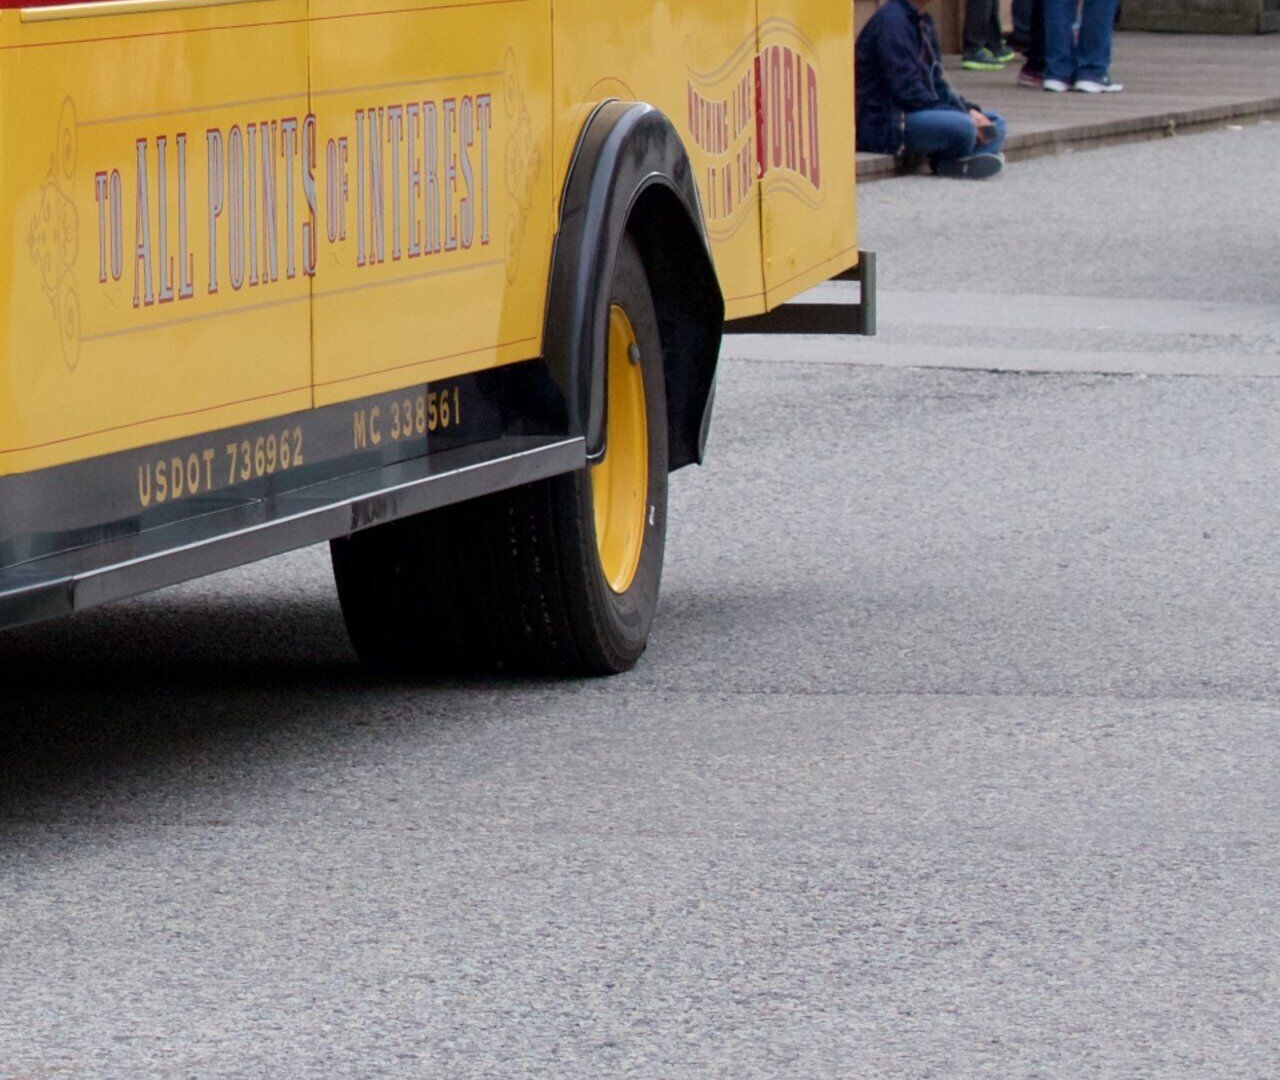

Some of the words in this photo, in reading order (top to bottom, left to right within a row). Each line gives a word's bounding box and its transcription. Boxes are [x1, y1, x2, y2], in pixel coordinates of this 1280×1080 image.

[754, 45, 821, 191] WORLD
[95, 168, 122, 283] TO
[133, 132, 193, 308] ALL
[206, 113, 317, 294] POINTS
[326, 136, 348, 243] OF
[355, 93, 491, 267] INTEREST
[139, 445, 214, 507] USDOT
[226, 426, 303, 485] 736962
[352, 405, 381, 450] MC
[391, 386, 461, 440] 338561
